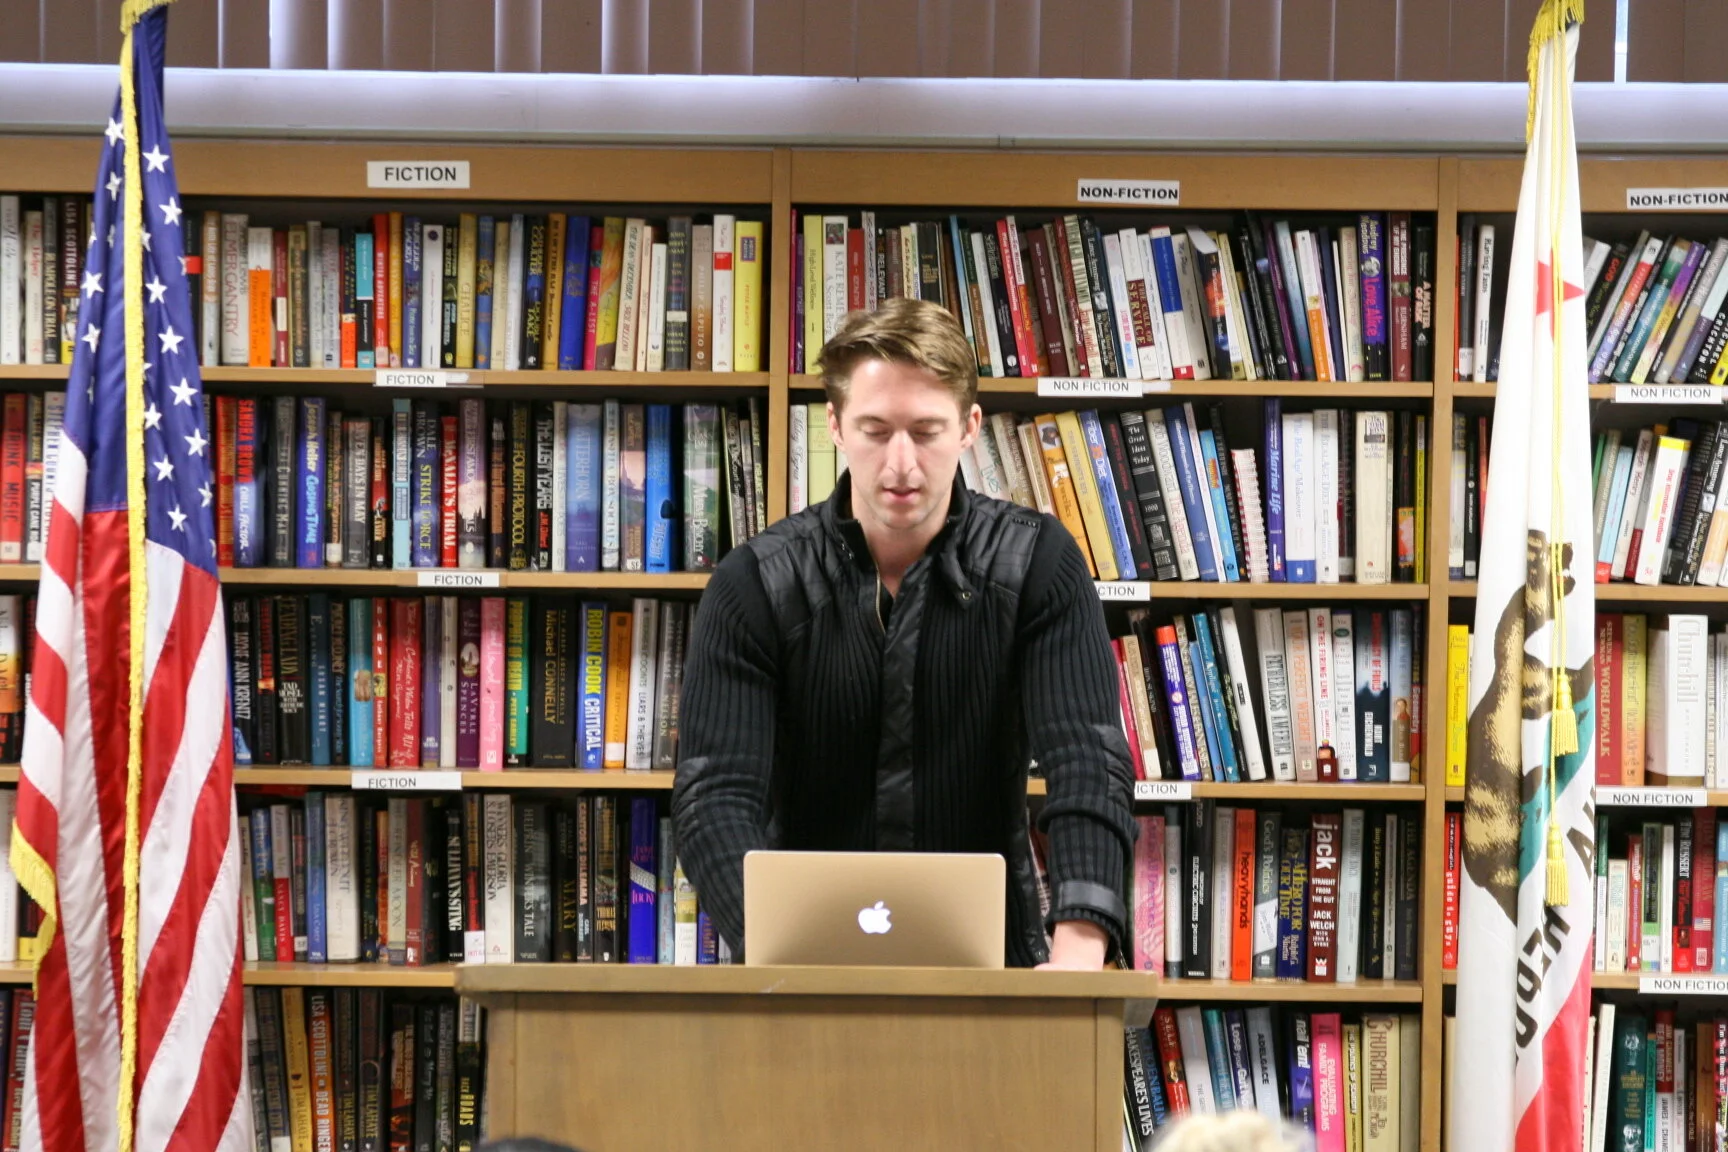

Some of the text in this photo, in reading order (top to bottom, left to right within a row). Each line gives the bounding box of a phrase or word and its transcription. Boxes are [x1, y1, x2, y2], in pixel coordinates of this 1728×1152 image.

[384, 167, 456, 181] FICTION
[1081, 187, 1178, 199] NON-FICTION
[1630, 193, 1728, 206] NON-FICTION
[65, 203, 80, 286] LISA SCOTTOLINE
[529, 226, 539, 276] COULTER
[1368, 220, 1379, 250] Audrey
[44, 252, 57, 338] RUMPOLE ON TRIAL
[224, 222, 239, 336] ELMER GANTRY
[877, 253, 885, 299] RELEVANT
[459, 282, 471, 337] CHALICE
[526, 308, 536, 338] TAKE
[588, 280, 598, 333] THE A-LIST
[696, 304, 705, 347] CAPUTO
[1127, 281, 1146, 345] SERVICE
[1422, 281, 1431, 329] A MATTER
[1699, 312, 1726, 364] CRICHTON
[386, 374, 435, 385] FICTION
[1053, 381, 1129, 391] NON FICTION
[1631, 388, 1711, 398] NON FICTION
[237, 399, 255, 483] SANDRA BROWN
[304, 399, 320, 472] Joseph Heller
[417, 411, 426, 459] BROWN
[427, 419, 436, 450] DALE
[752, 412, 760, 446] GRANT
[1086, 420, 1106, 479] Fiber 35 Diet
[4, 428, 20, 522] TRUNK MUSIC
[354, 422, 367, 524] SEVEN DAYS IN MAY
[537, 419, 552, 509] THE LOST YEARS
[1157, 439, 1177, 493] Woodward
[1270, 449, 1280, 514] Marine Life
[30, 482, 41, 530] PURPLE CANE
[420, 464, 432, 549] STRIKE FORCE
[444, 439, 457, 549] McNALLY'S TRIAL
[512, 449, 526, 547] FOURTH PROTOCOL
[1295, 478, 1304, 518] Makeover
[239, 513, 251, 550] FACTOR
[693, 518, 708, 553] BINCHY
[434, 575, 483, 585] FICTION
[1098, 586, 1135, 596] CTION
[234, 632, 251, 720] JAYNE ANN KRENTZ
[508, 601, 523, 748] PROPHET DEATH PETE EARLEY
[545, 610, 557, 724] Michael CONNELLY
[584, 609, 603, 751] ROBIN COOK CRITICAL
[1317, 615, 1323, 628] ON
[1320, 680, 1328, 698] LINE
[1676, 618, 1700, 704] Churchill
[459, 682, 469, 734] SPENCER
[636, 692, 647, 756] LIARS THIEVES
[659, 694, 669, 737] NELSON
[1266, 655, 1291, 757] FATHERLESS AMERICA
[1296, 655, 1311, 741] PERFECT WEIGHT
[1411, 686, 1420, 733] Geometry
[1600, 665, 1610, 757] WORLDWALK
[368, 777, 417, 788] FICTION
[1137, 784, 1177, 794] ICTION
[1612, 793, 1693, 804] NON FICTION
[486, 809, 497, 900] LOSERS EMERSON
[496, 800, 507, 890] WINNERS GLORIA
[523, 809, 534, 853] HELPRIN
[579, 802, 588, 906] CANTOR'S DILEMMA
[1312, 822, 1338, 870] jack
[256, 853, 267, 876] Pro
[447, 835, 462, 931] SULLIVAN'S STING
[1262, 820, 1275, 895] God's Politics
[1679, 840, 1691, 878] RUSSERT
[563, 880, 574, 931] MARY
[1239, 852, 1251, 929] heavyhands
[1279, 860, 1293, 920] OUR TIME
[1291, 869, 1308, 930] HERO FOR
[1313, 910, 1331, 920] JACK
[1444, 871, 1456, 947] guide to guys
[278, 916, 286, 942] DAVIS
[523, 913, 534, 937] TALE
[1310, 920, 1335, 931] WELCH
[1654, 980, 1681, 990] NON
[1231, 1023, 1248, 1089] Lose Gut
[1257, 1033, 1270, 1085] ADELGACE
[1295, 1020, 1311, 1069] nail 'em!
[1367, 1018, 1393, 1093] CHURCHILL
[1656, 1047, 1665, 1083] MONEY
[1719, 1056, 1727, 1076] Done
[312, 995, 332, 1152] LISA SCOTTOLINE DEAD RINGER
[1318, 1042, 1330, 1131] FAMILY PROGRAMS
[344, 1092, 355, 1141] TIM LAHAYE
[366, 1085, 378, 1138] TIM LAHAYE
[460, 1093, 474, 1126] ROADS
[1138, 1105, 1154, 1136] LIVES
